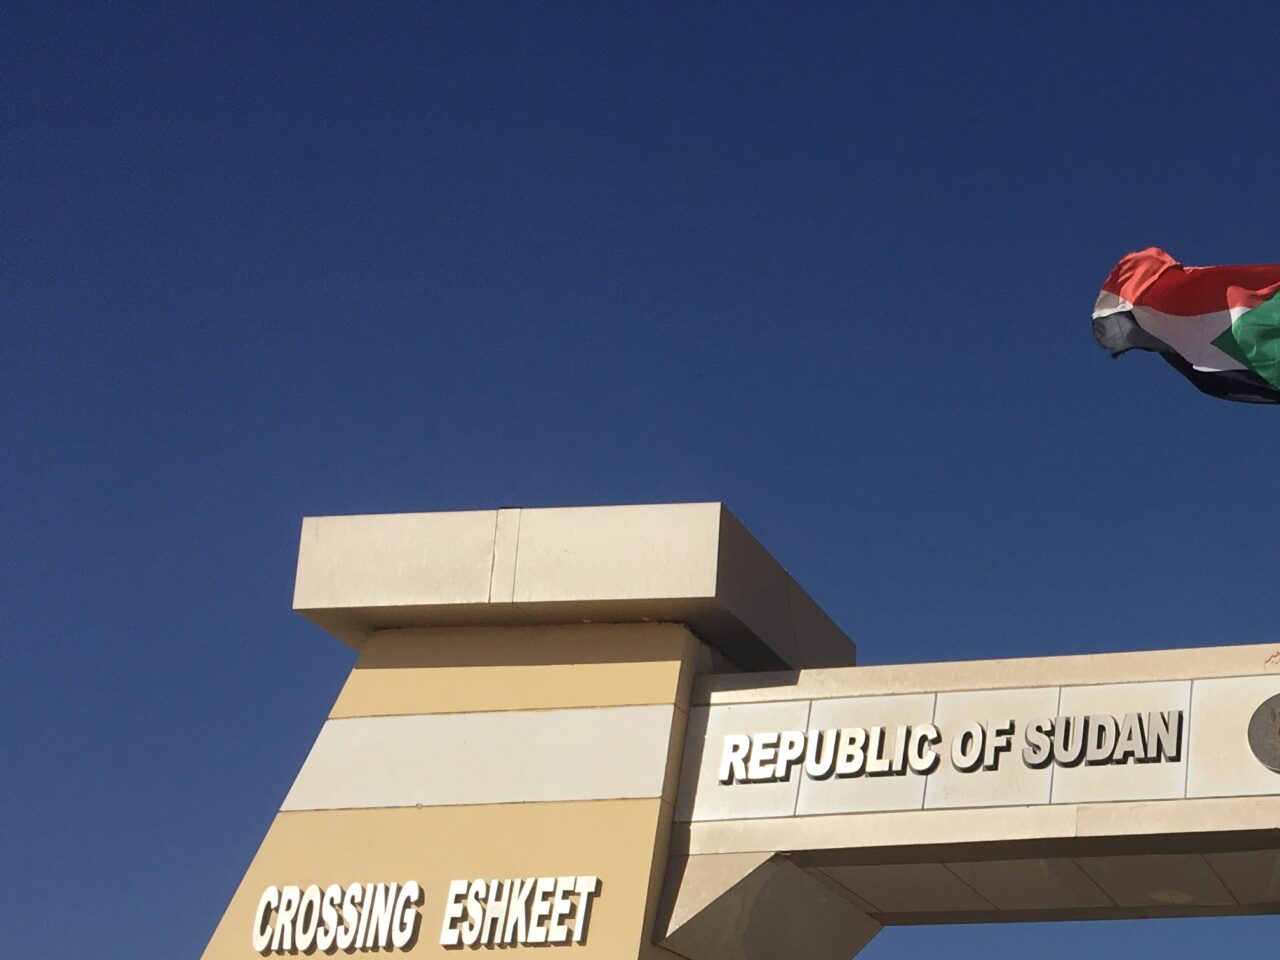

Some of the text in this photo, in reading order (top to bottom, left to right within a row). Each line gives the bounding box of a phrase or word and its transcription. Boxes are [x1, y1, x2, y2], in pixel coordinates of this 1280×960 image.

[718, 710, 1184, 785] REPUBLIC OF SUDAN
[252, 875, 603, 957] CROSSING ESHKEET
